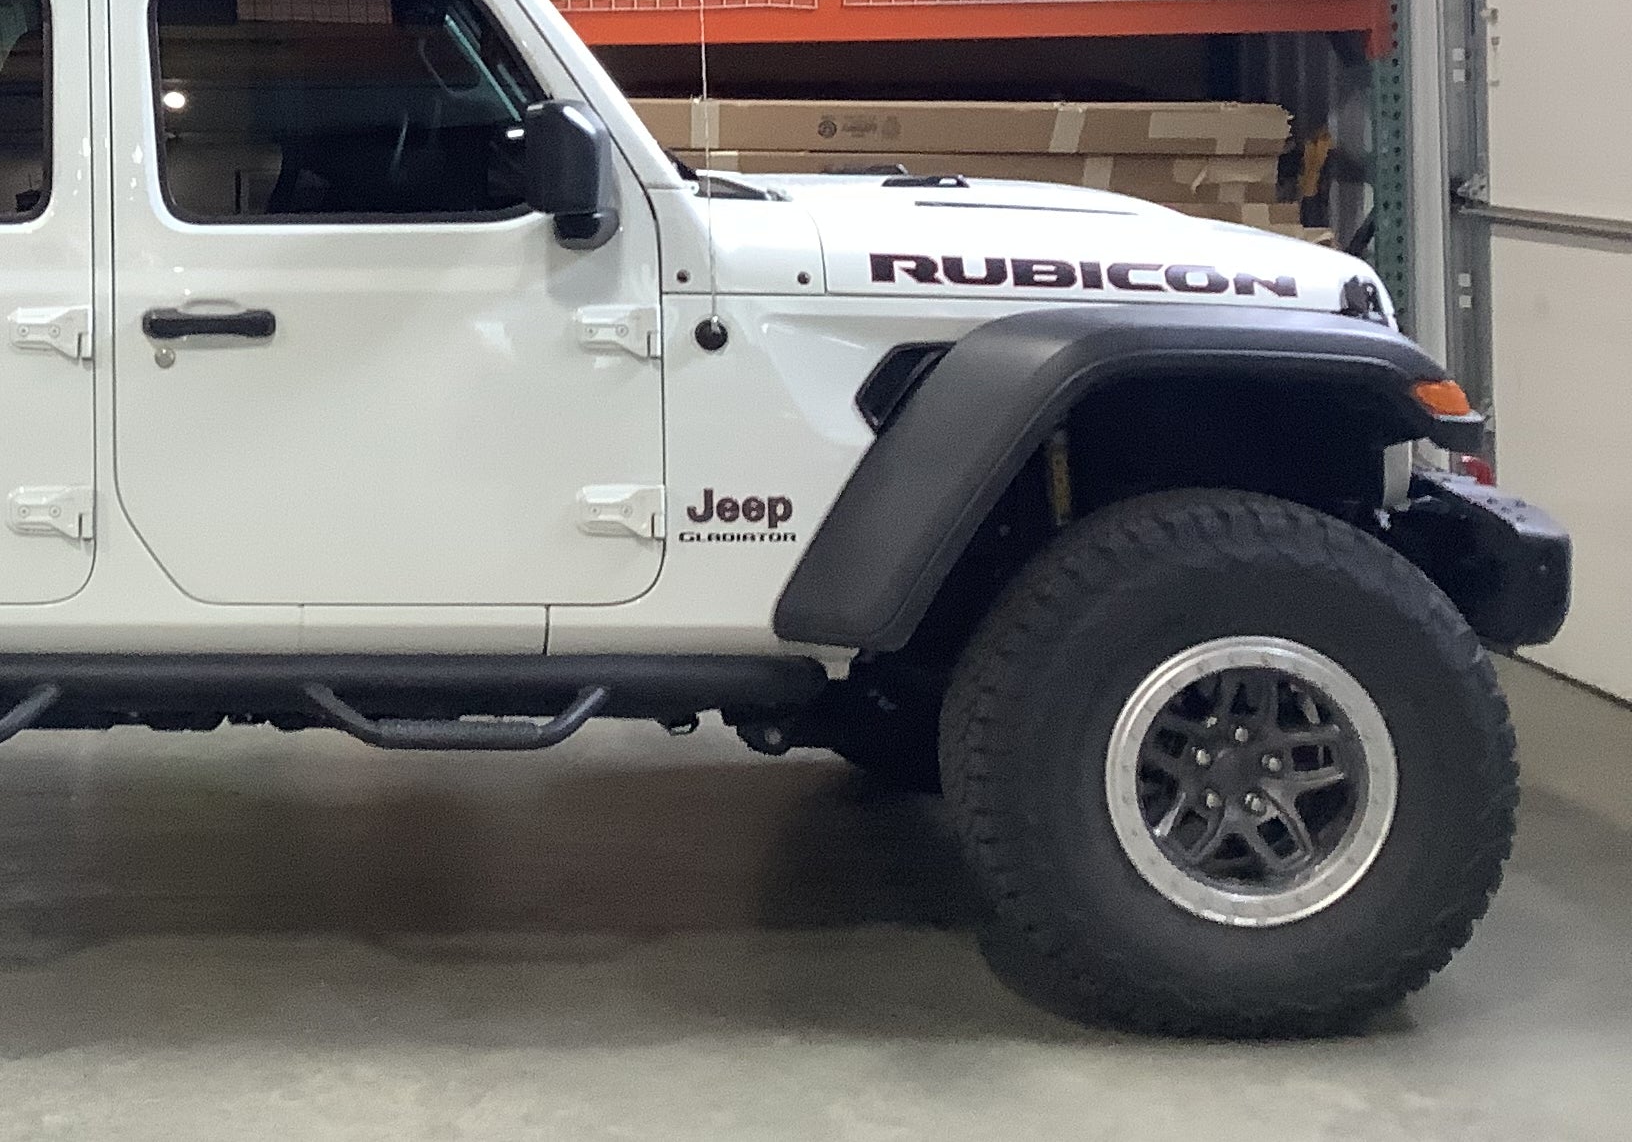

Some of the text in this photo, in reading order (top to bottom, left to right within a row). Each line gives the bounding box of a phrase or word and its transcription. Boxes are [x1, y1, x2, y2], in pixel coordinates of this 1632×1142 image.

[869, 253, 1298, 298] RUBICON
[687, 488, 793, 529] Jeep
[678, 532, 797, 542] GLADIATOR
